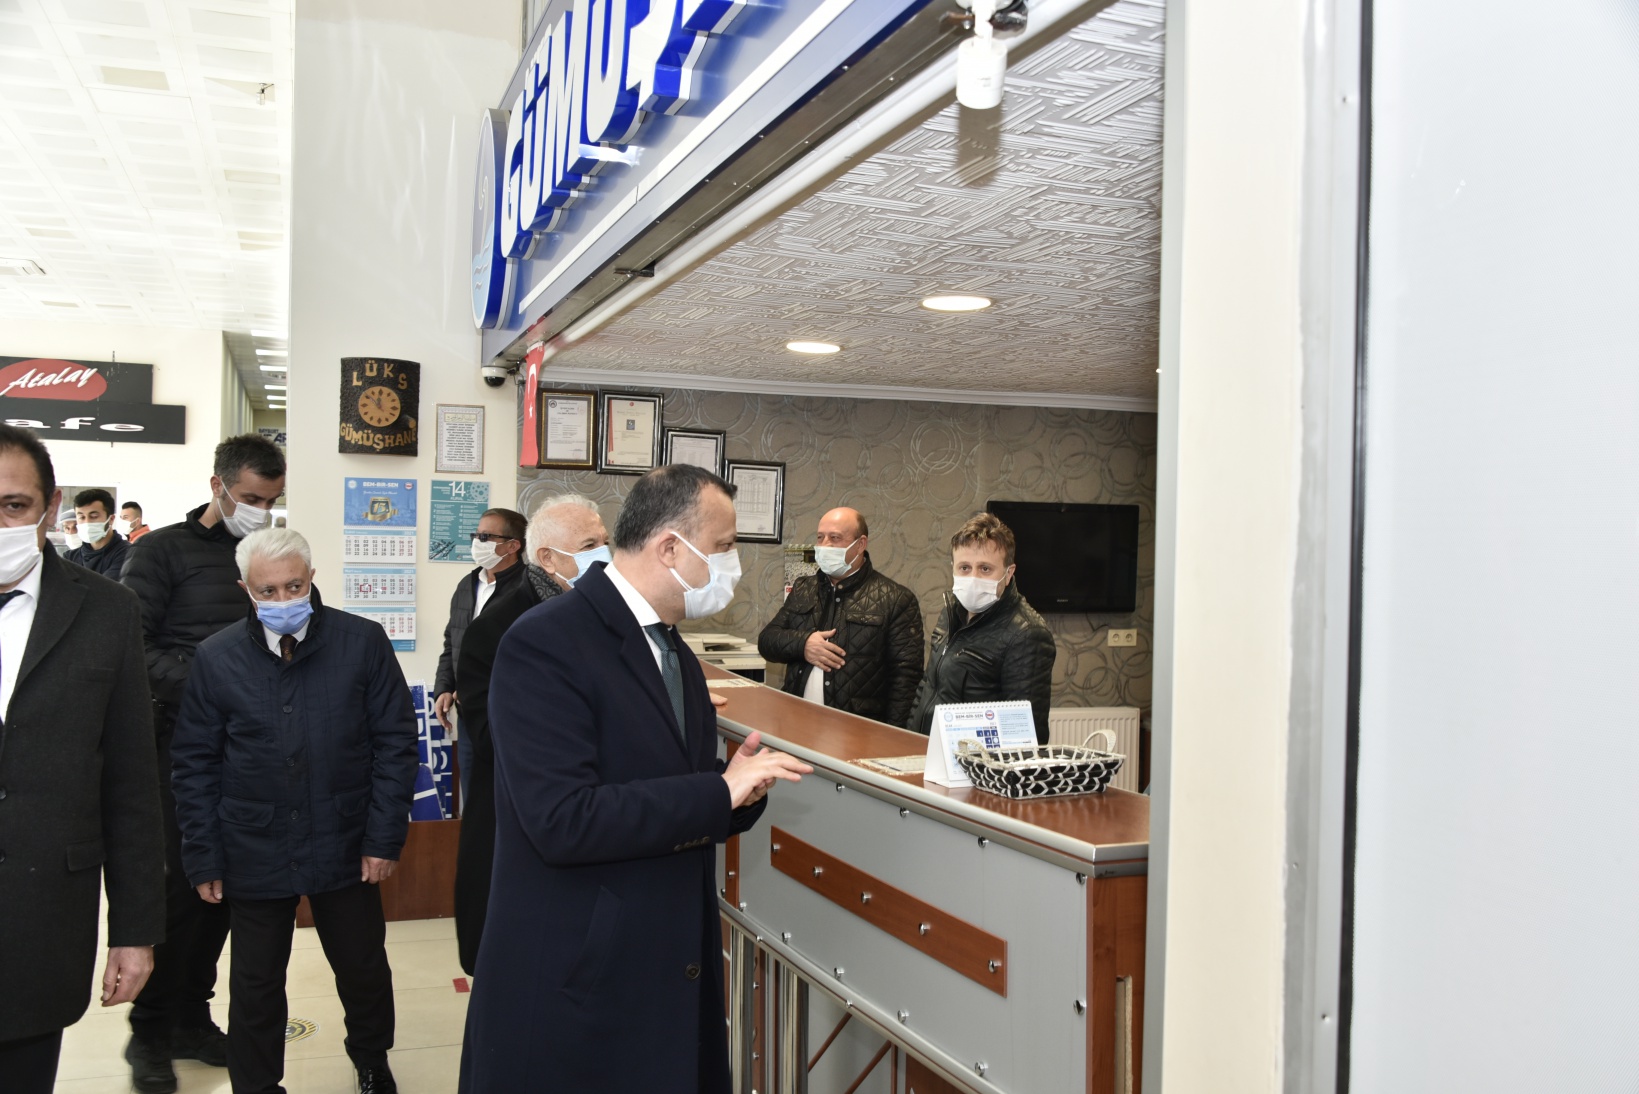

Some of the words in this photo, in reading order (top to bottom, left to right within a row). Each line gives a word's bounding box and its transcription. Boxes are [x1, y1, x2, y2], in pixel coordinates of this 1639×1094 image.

[352, 360, 408, 390] LÜKS
[340, 422, 417, 452] GÜMÜŞHANE
[448, 481, 466, 497] 14
